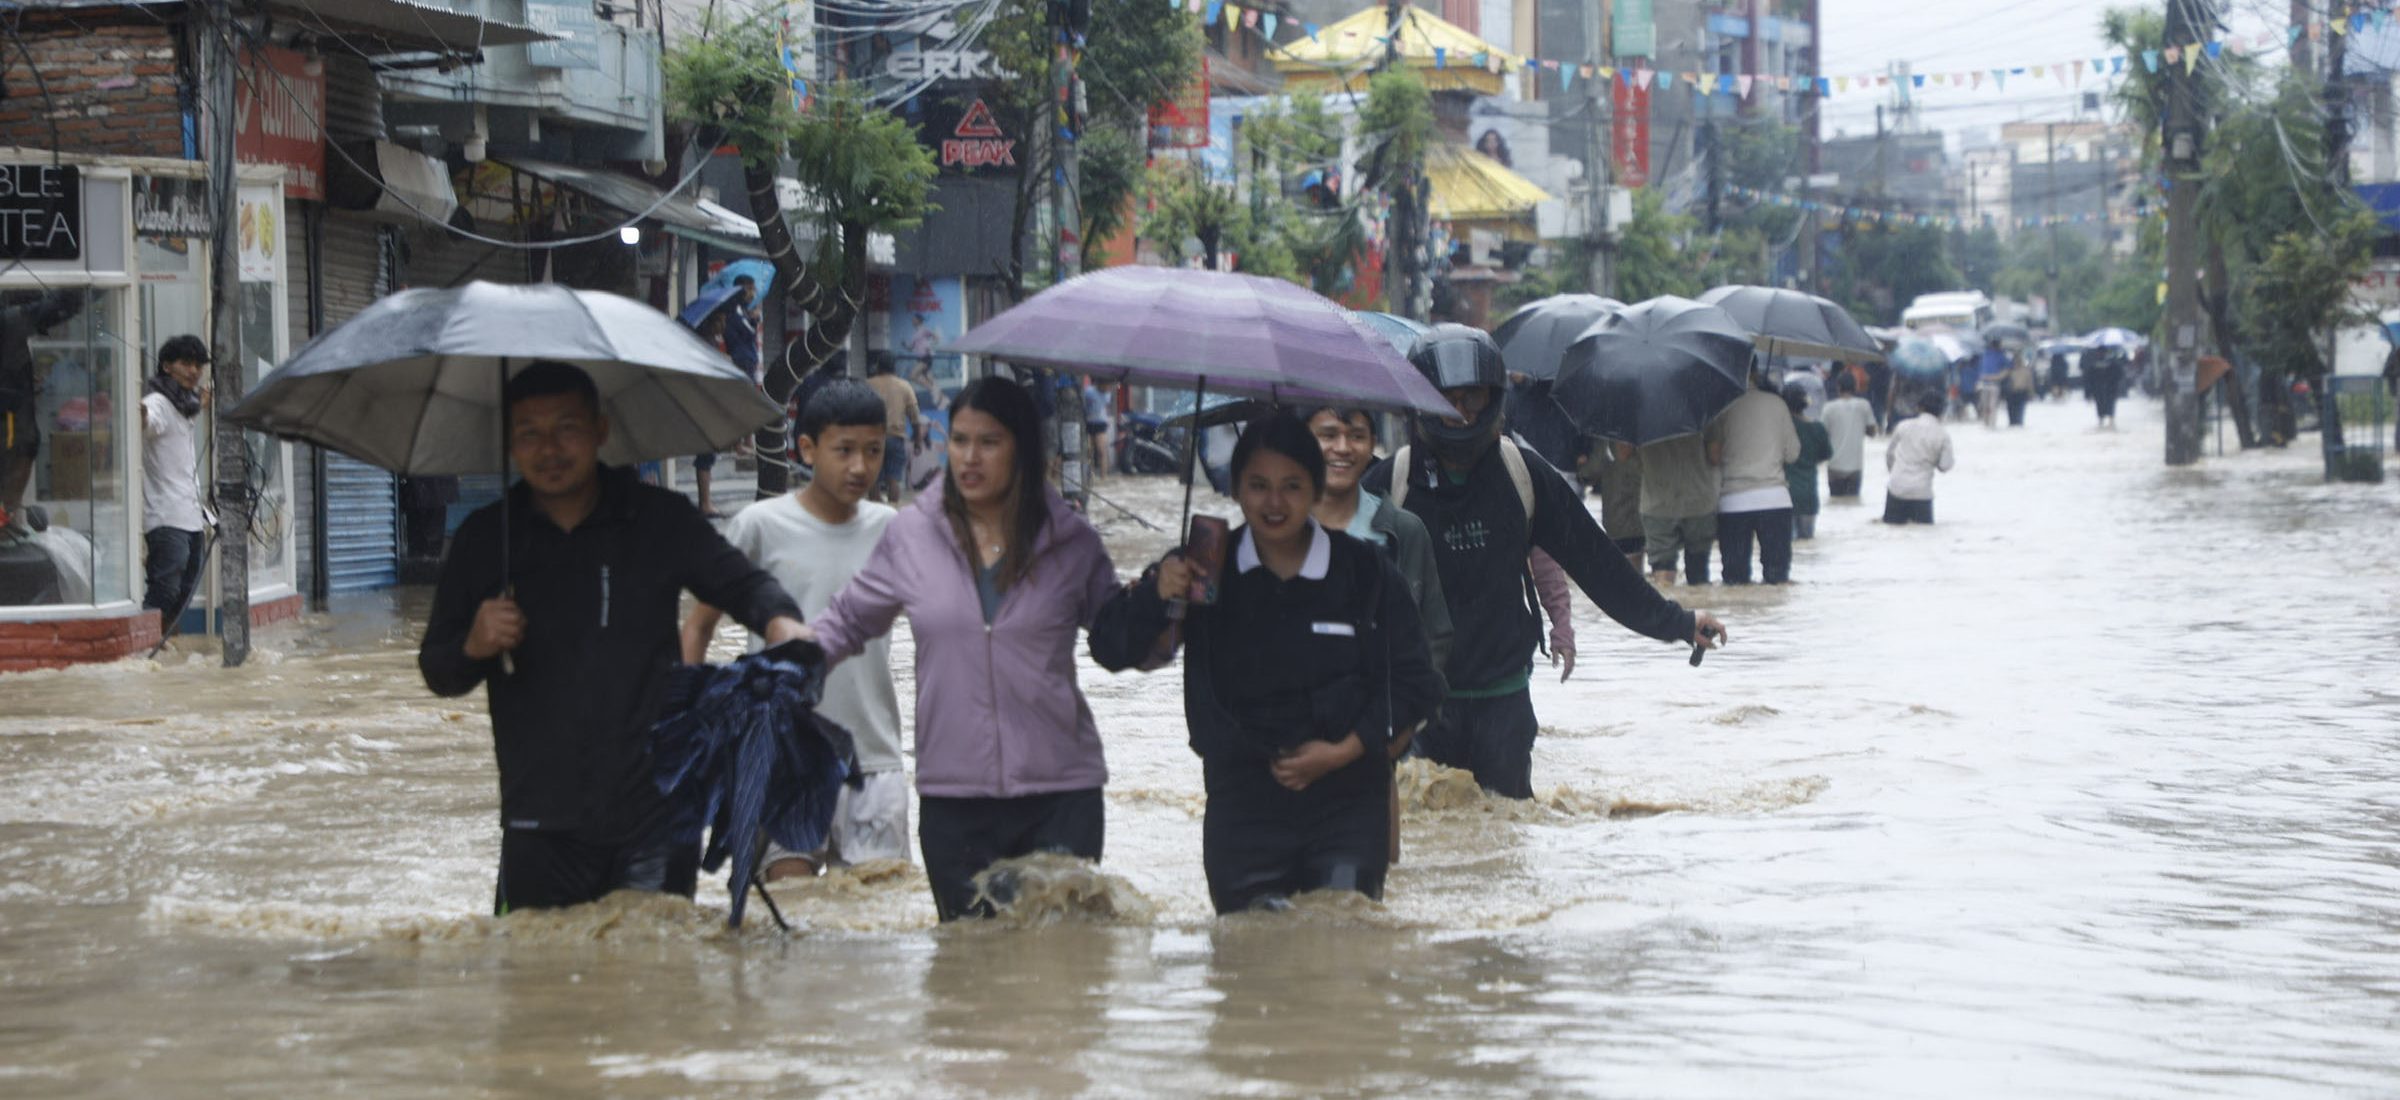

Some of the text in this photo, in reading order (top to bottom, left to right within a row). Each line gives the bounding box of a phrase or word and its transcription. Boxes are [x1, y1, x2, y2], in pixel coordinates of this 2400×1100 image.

[260, 69, 320, 144] CLOTHING
[942, 138, 1016, 167] PEAK
[0, 165, 64, 197] BLE
[0, 208, 77, 248] TEA
